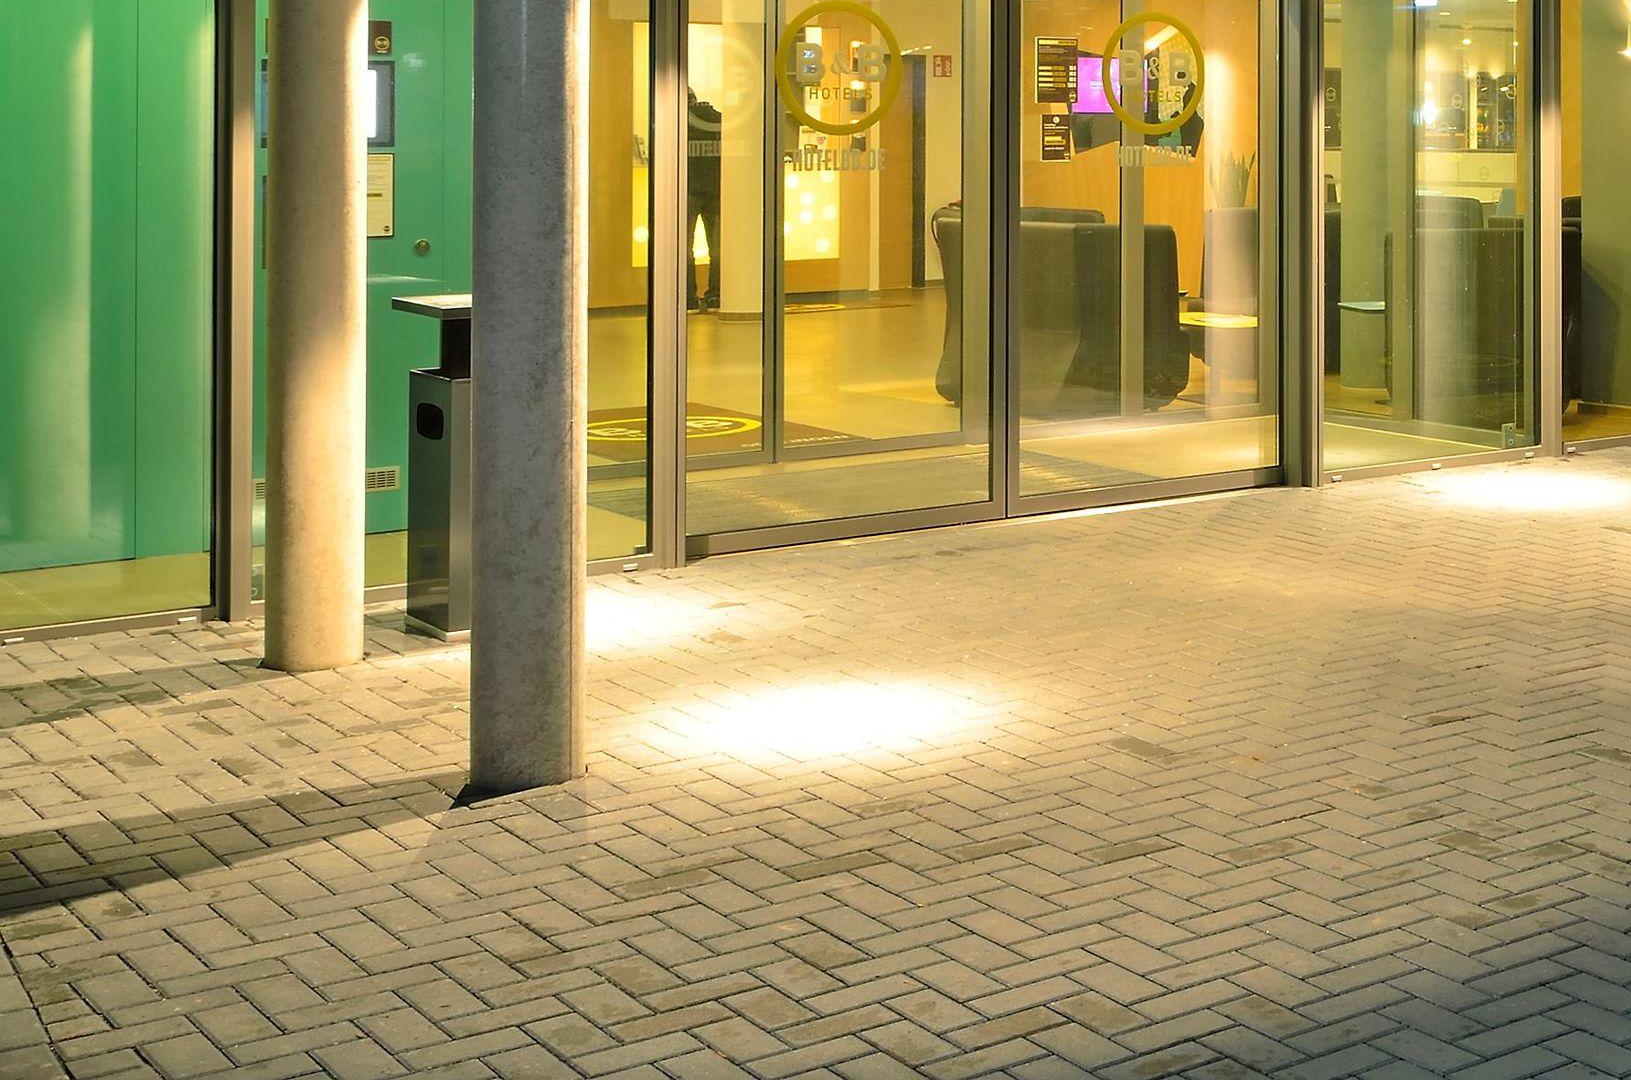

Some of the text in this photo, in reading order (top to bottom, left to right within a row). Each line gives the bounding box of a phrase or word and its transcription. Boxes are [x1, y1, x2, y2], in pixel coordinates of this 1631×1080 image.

[809, 87, 873, 100] HOTELS
[1127, 90, 1181, 102] TELS
[1117, 145, 1192, 168] HOTBBDE
